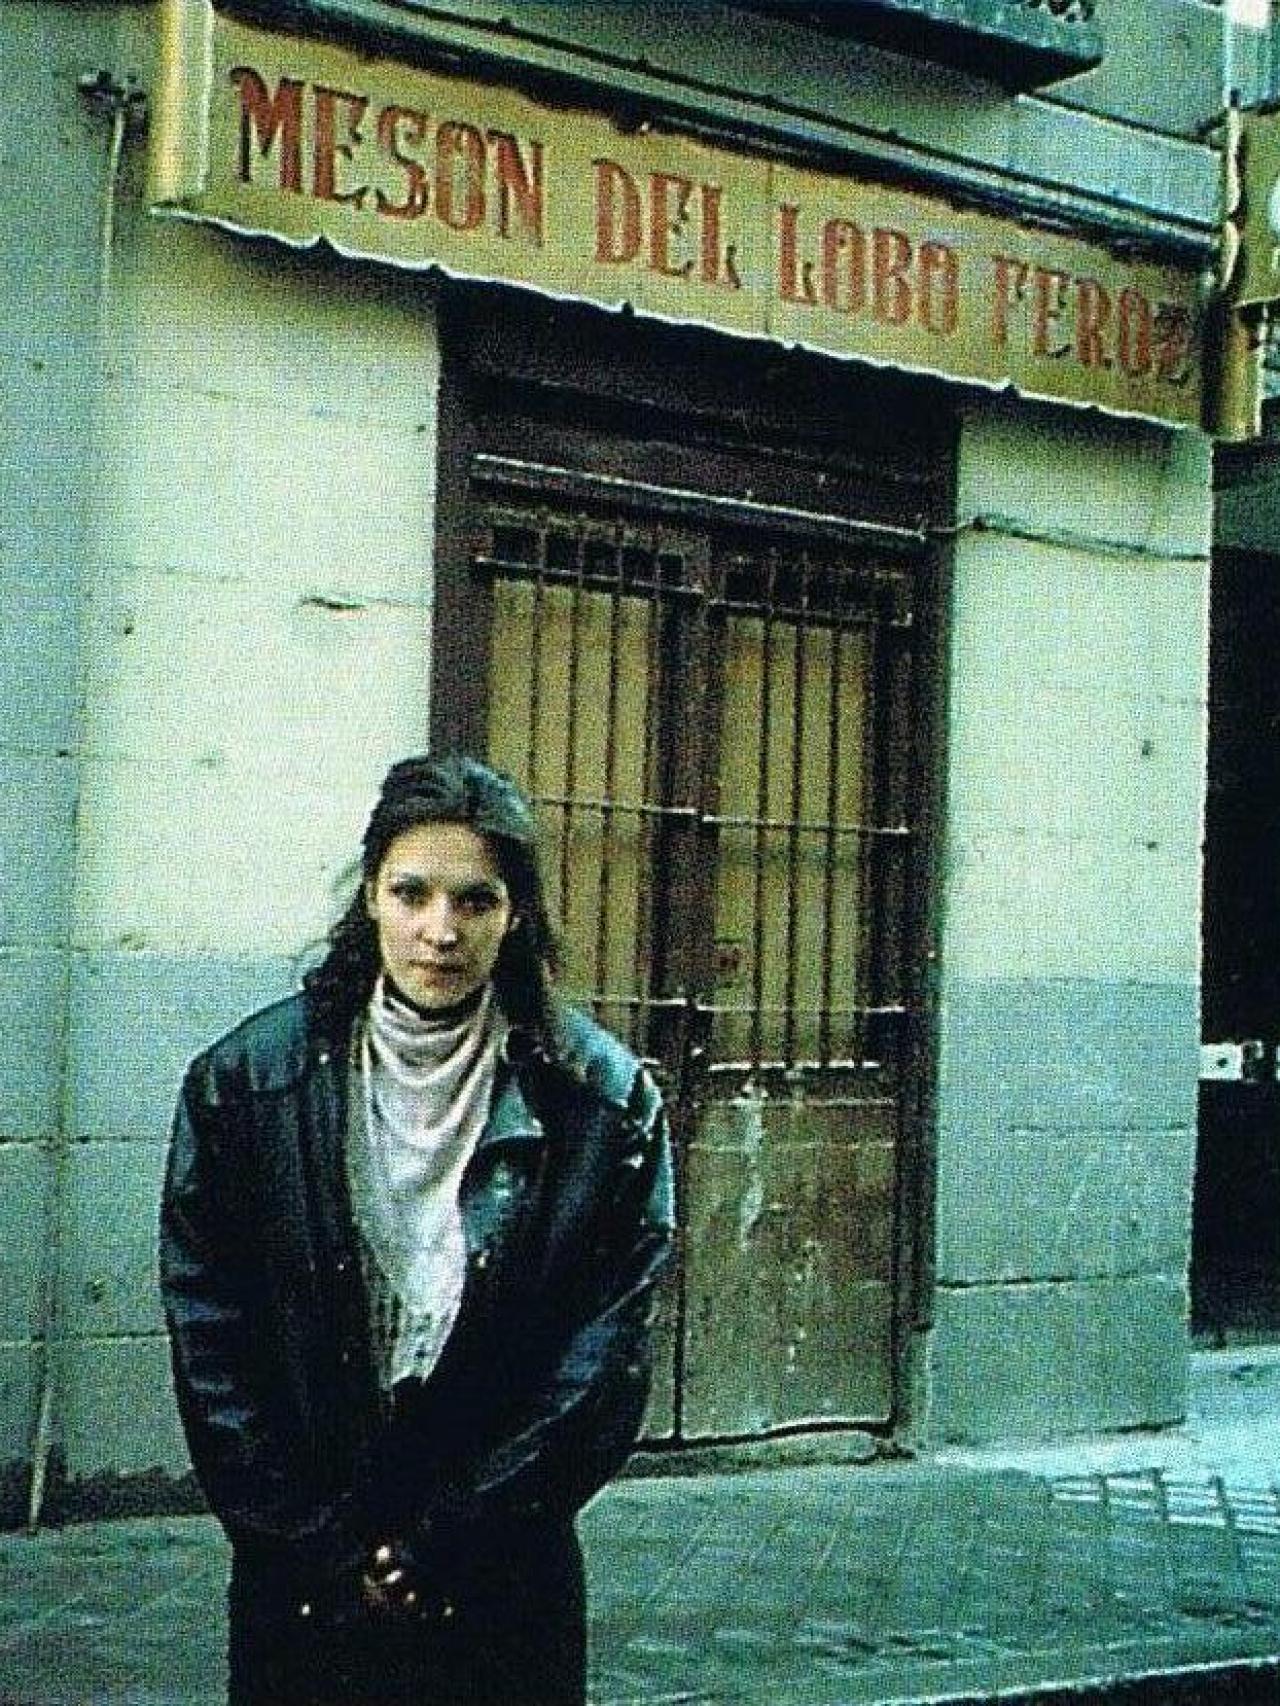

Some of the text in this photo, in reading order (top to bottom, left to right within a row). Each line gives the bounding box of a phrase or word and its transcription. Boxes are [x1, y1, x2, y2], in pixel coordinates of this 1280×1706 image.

[230, 66, 544, 247] MESON
[594, 157, 741, 290] DEL
[778, 202, 959, 340] LOBO
